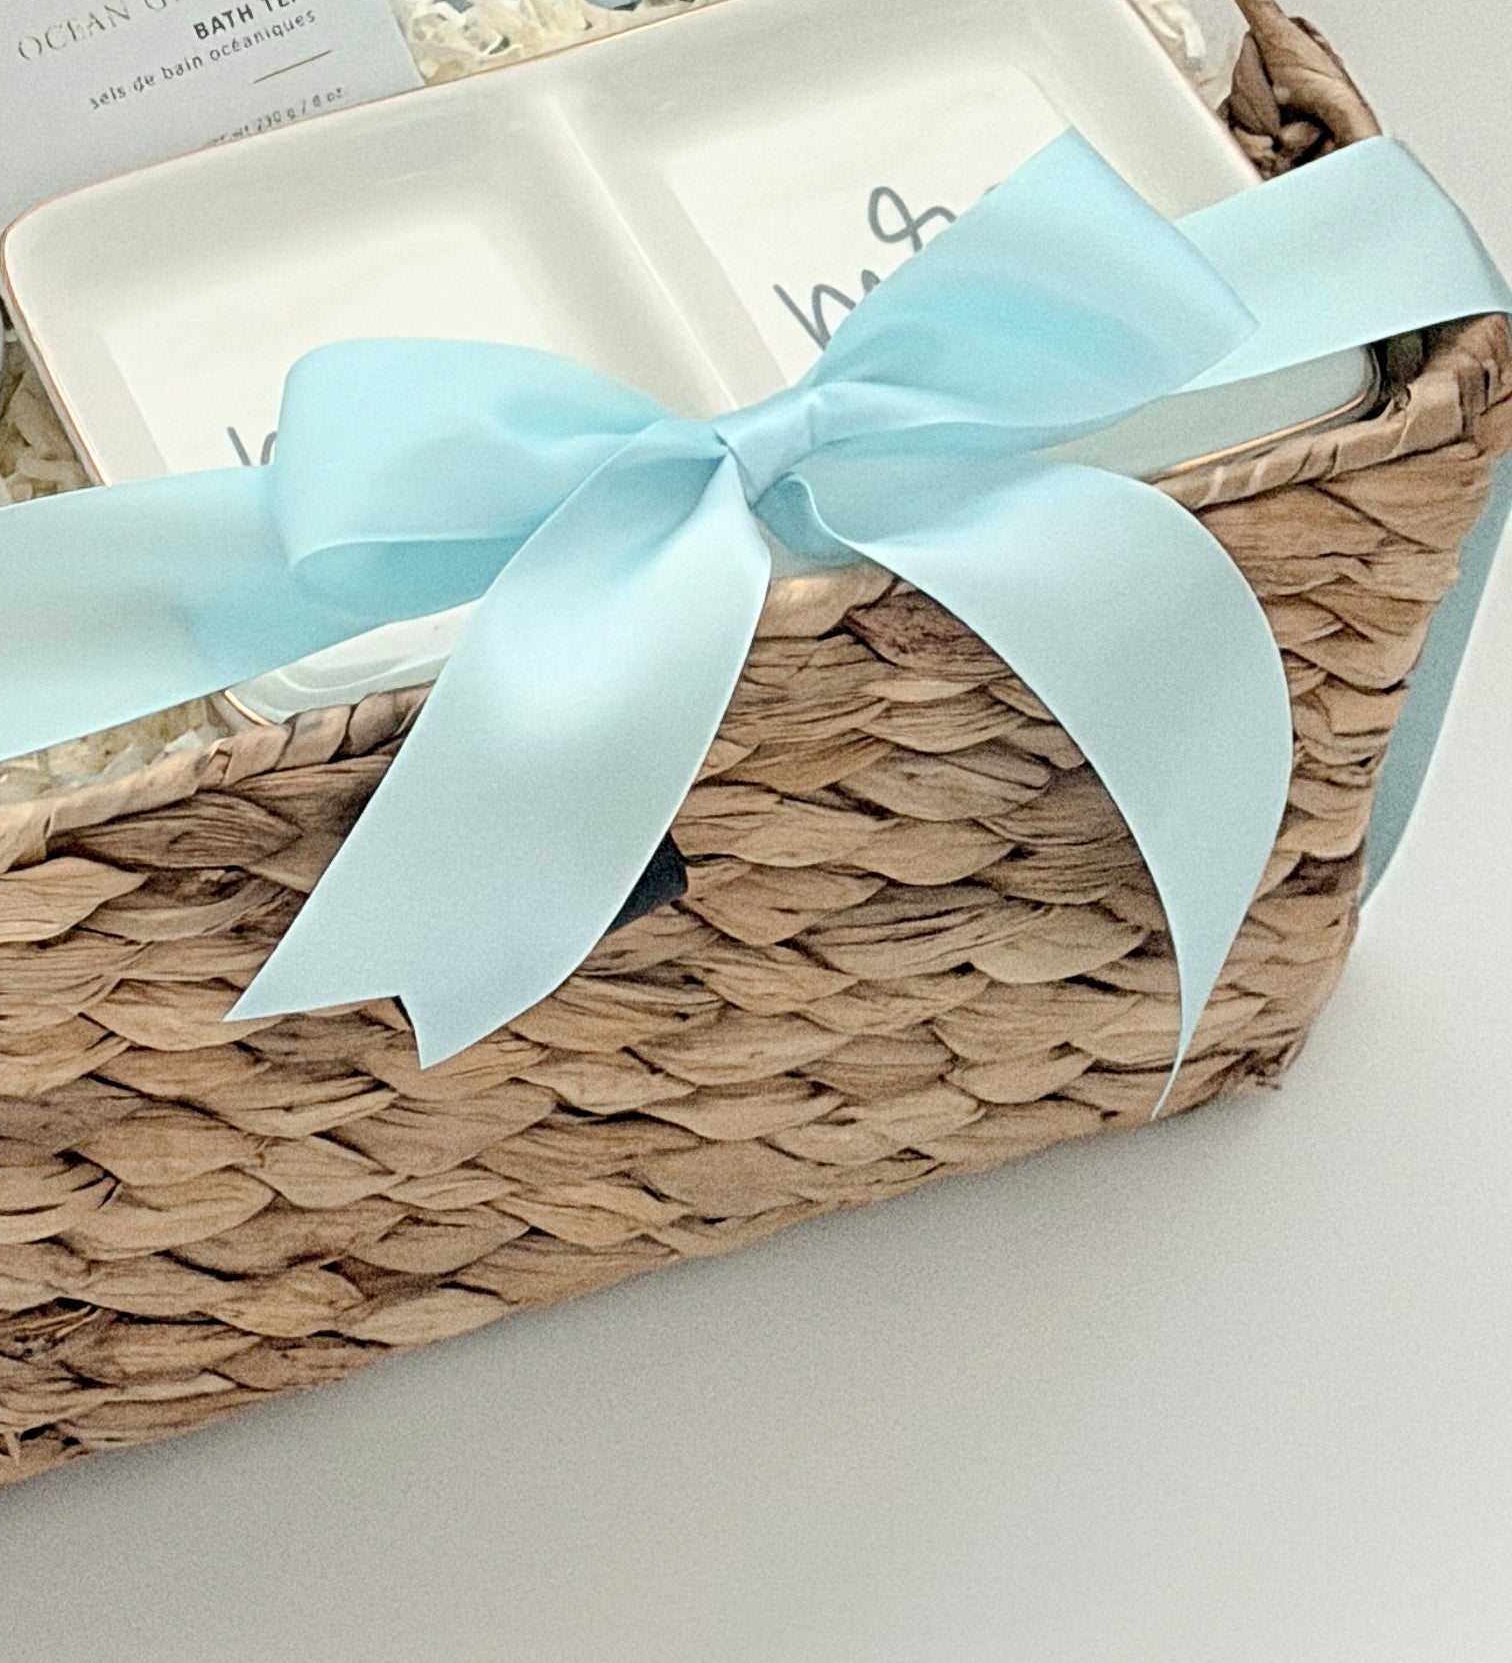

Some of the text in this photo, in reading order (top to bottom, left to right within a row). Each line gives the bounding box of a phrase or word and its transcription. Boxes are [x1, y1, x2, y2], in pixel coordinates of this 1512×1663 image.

[17, 2, 133, 61] OCEAN
[193, 4, 254, 40] BATH
[90, 9, 316, 111] sels de bain océaniques
